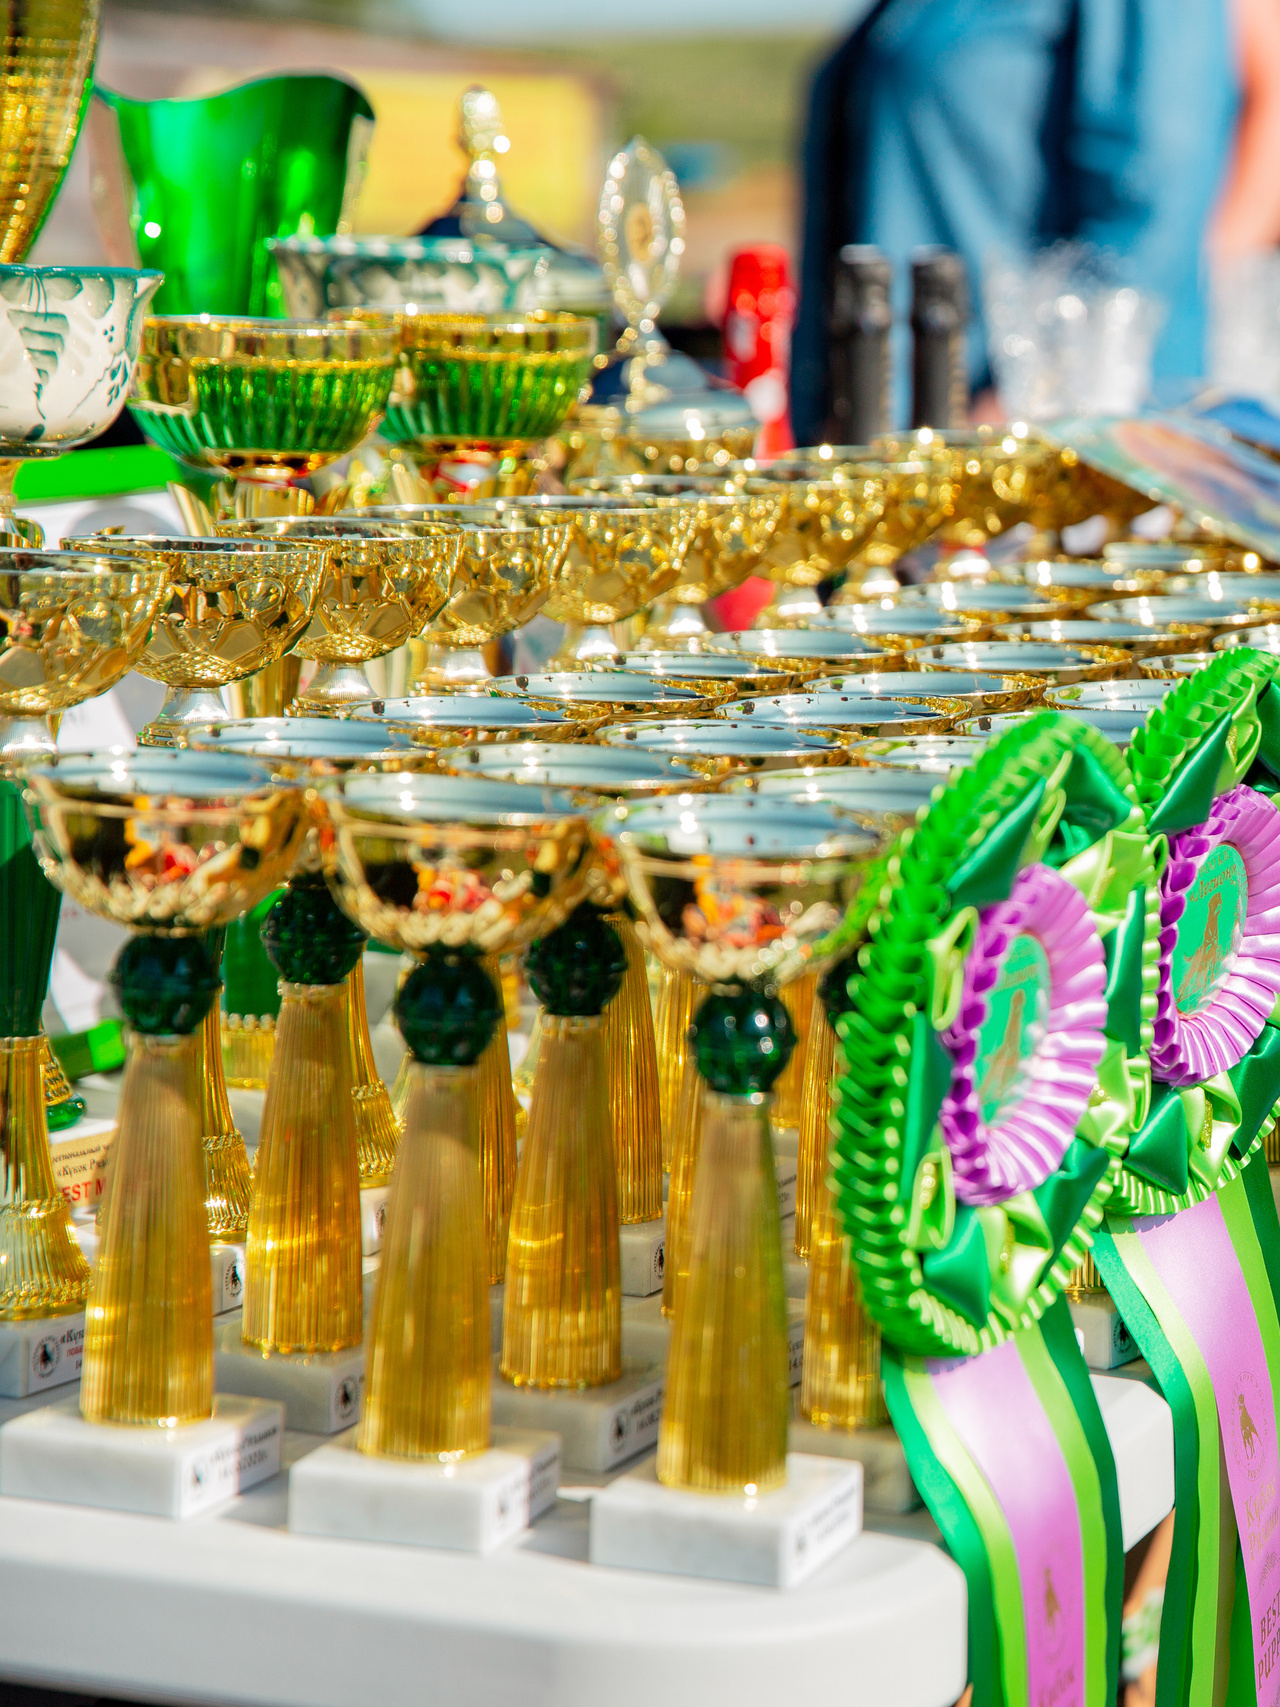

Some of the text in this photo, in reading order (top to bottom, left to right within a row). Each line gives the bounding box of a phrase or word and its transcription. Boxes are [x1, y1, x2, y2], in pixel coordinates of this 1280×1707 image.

[1245, 1476, 1275, 1528] Кубок
[1248, 1507, 1279, 1561] Рязани
[1260, 1588, 1280, 1647] BEST
